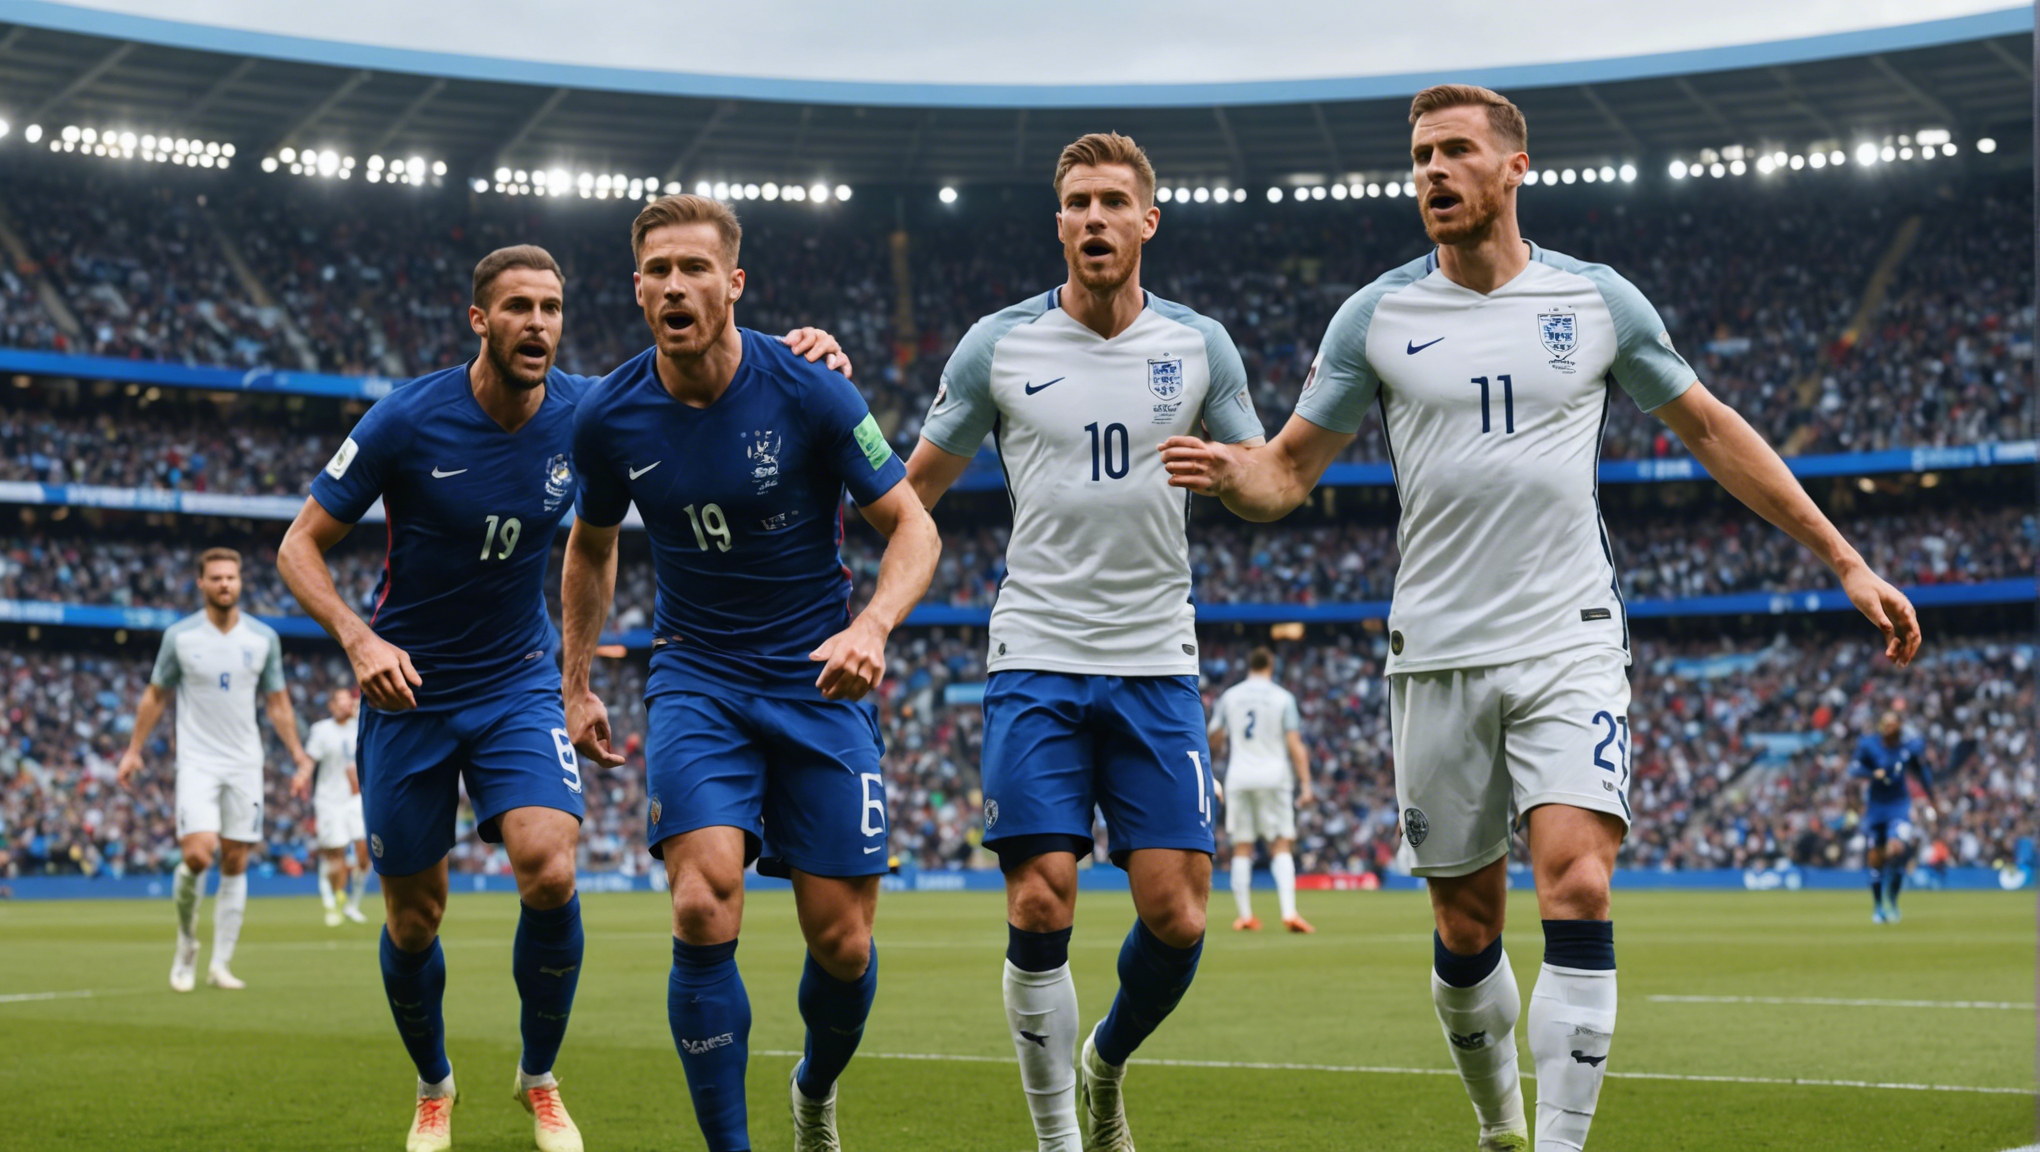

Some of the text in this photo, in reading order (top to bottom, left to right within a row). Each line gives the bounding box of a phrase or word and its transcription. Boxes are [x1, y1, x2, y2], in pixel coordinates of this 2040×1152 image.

[1471, 374, 1514, 434] 11
[1084, 421, 1130, 481] 10
[480, 515, 522, 560] 19
[683, 503, 732, 553] 19
[1245, 709, 1256, 739] 2
[861, 772, 886, 837] 6
